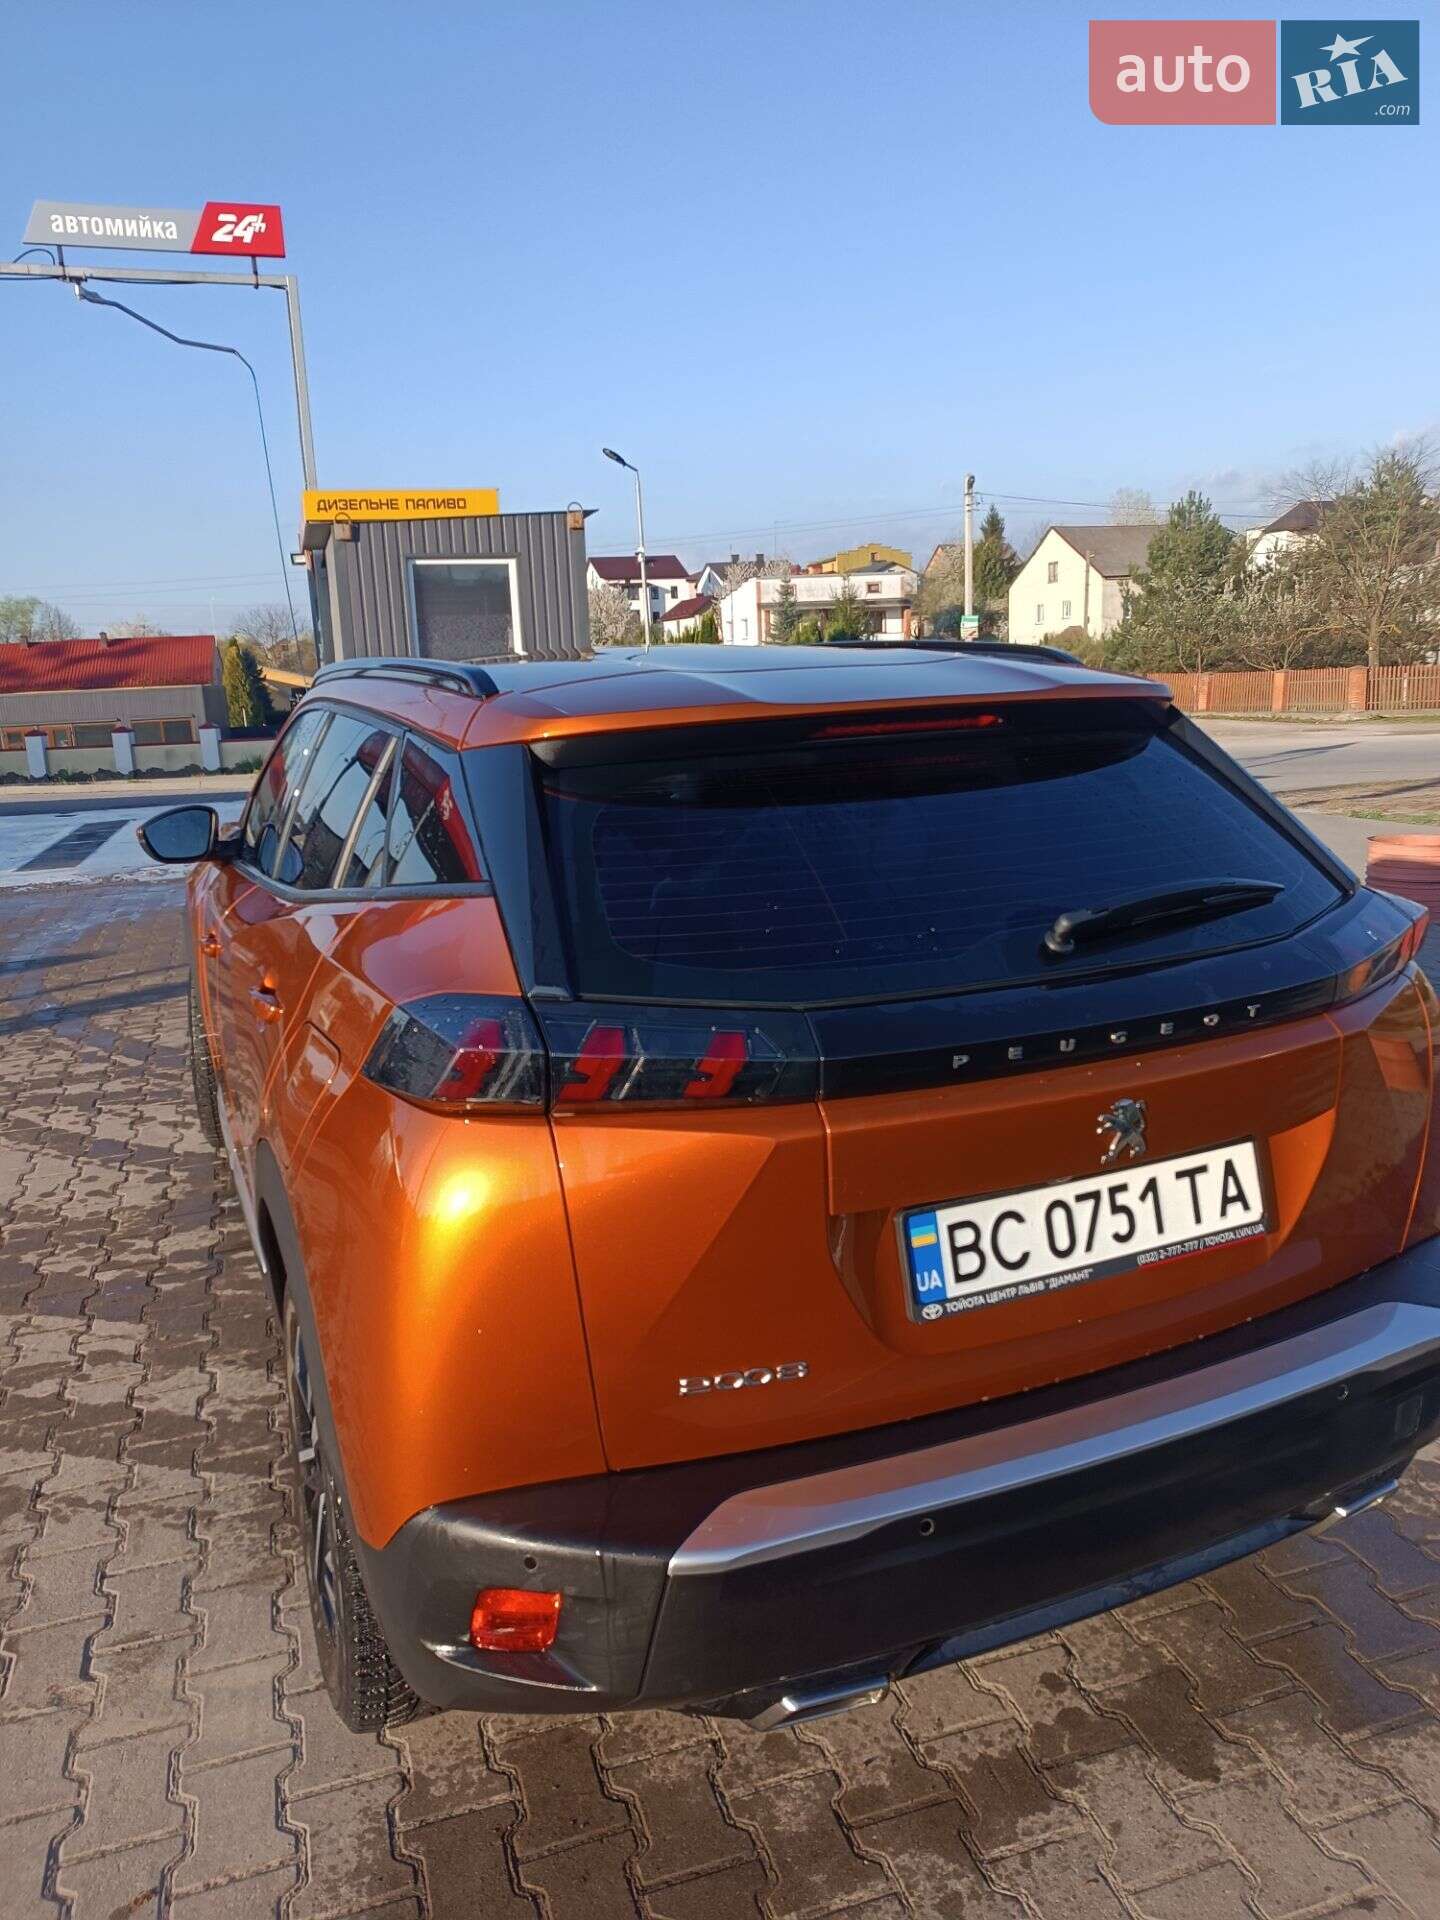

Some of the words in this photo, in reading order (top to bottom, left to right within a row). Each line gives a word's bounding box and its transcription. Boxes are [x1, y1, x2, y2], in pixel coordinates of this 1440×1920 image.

[50, 214, 178, 240] автомийка
[316, 498, 400, 512] ДИЗЕЛЬНЕ
[405, 497, 467, 510] ПАЛИВО
[952, 1004, 1261, 1069] PEUGEOT
[947, 1210, 1031, 1283] BC
[1045, 1176, 1165, 1259] 0751
[1175, 1158, 1251, 1225] TA
[917, 1269, 943, 1292] UA
[679, 1361, 808, 1396] 2008
